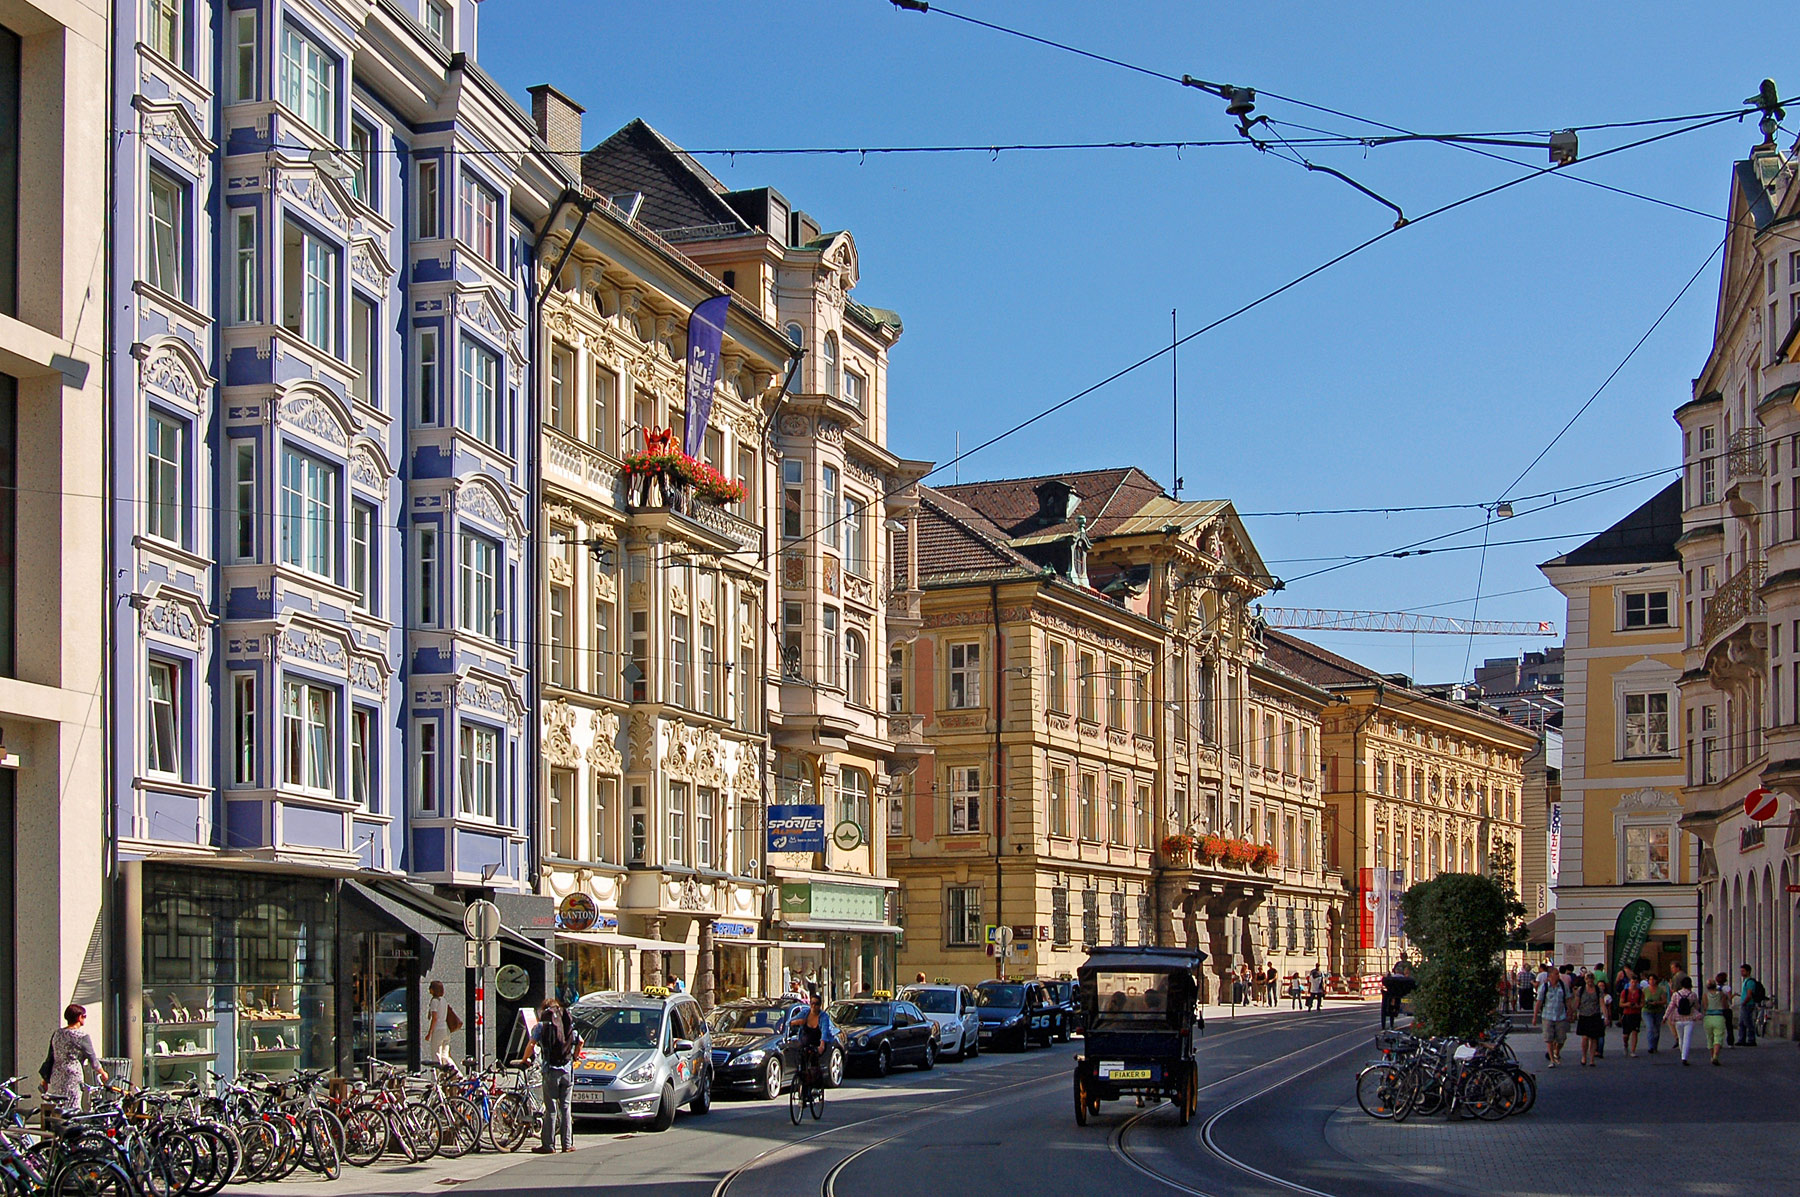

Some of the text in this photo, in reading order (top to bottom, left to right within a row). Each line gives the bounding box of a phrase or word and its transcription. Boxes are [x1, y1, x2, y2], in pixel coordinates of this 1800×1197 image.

[768, 816, 824, 832] SPORTLER
[1551, 804, 1561, 863] INTERSPORT
[560, 910, 594, 919] CANTON
[1629, 906, 1646, 938] COLORS
[646, 986, 666, 994] TAXI
[1031, 1015, 1050, 1029] 56
[583, 1061, 617, 1071] 500
